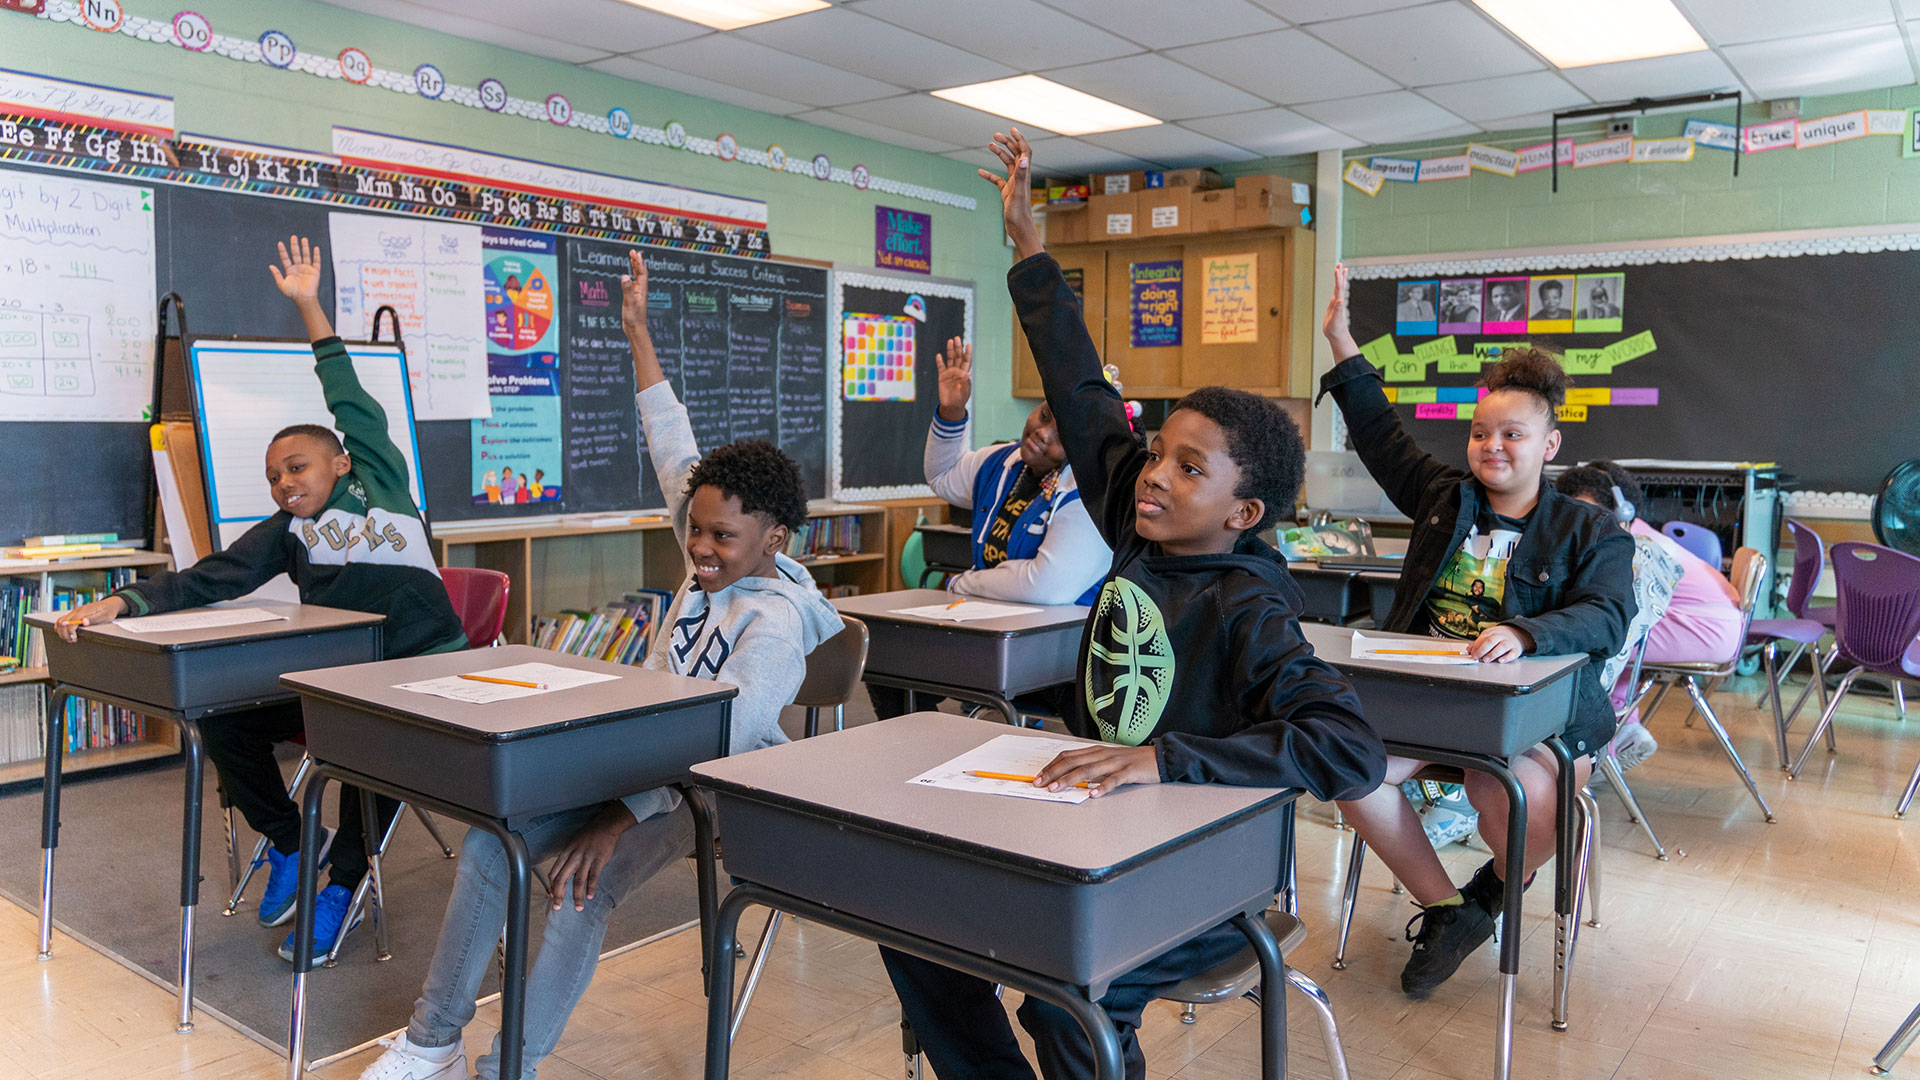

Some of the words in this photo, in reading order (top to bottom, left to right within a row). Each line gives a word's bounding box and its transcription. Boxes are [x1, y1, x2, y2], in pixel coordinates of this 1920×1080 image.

[87, 0, 116, 22] Nn
[178, 20, 208, 43] Oo
[267, 37, 291, 61] Pp
[344, 55, 366, 76] Qq
[420, 74, 441, 92] Rr
[483, 86, 502, 104] Ss
[551, 100, 566, 118] Tt
[613, 115, 629, 133] Uu
[1803, 119, 1856, 141] unique
[1, 122, 34, 146] Ee
[44, 126, 75, 153] Ff
[86, 135, 121, 163] Gg
[131, 140, 168, 166] Hh
[1751, 129, 1792, 146] true
[1470, 150, 1517, 170] punctual
[1519, 145, 1571, 165] HUMLE
[1575, 142, 1631, 164] yourself
[199, 151, 221, 174] Ii
[229, 156, 251, 182] Jj
[256, 158, 290, 184] Kk
[296, 165, 320, 188] Ll
[1420, 163, 1465, 175] confident
[356, 174, 393, 197] Mm
[399, 178, 427, 202] Nn
[431, 186, 456, 207] Oo
[40, 185, 60, 212] by
[69, 188, 82, 210] 2
[93, 191, 132, 221] Digit
[481, 192, 504, 215] Pp
[508, 197, 531, 219] Qq
[536, 200, 558, 222] Rr
[562, 203, 580, 224] Ss
[5, 214, 101, 240] Multiplication
[589, 209, 609, 229] Tt
[611, 212, 632, 233] Uu
[636, 217, 657, 236] Vv
[660, 220, 684, 239] Ww
[888, 211, 923, 236] Make
[377, 231, 412, 247] Good
[499, 236, 509, 245] to
[509, 237, 527, 248] Feel
[527, 239, 548, 249] Calm
[695, 224, 717, 244] Xx
[722, 229, 741, 250] Yy
[747, 232, 763, 250] Zz
[886, 232, 923, 255] effort.
[577, 243, 633, 278] Learning
[644, 254, 685, 272] ntentions
[690, 262, 705, 275] and
[711, 260, 749, 279] Success
[752, 265, 786, 286] Criteria
[878, 250, 892, 265] Not
[19, 257, 37, 276] 18
[70, 260, 97, 279] 414
[1136, 265, 1182, 281] Integrity
[579, 281, 609, 300] Math
[686, 291, 717, 307] Writing
[1140, 288, 1177, 302] doing
[730, 293, 749, 305] Social
[750, 294, 774, 307] Studies
[1150, 299, 1179, 314] right
[1141, 312, 1174, 327] thing
[1576, 351, 1602, 369] my
[115, 364, 142, 378] 414
[488, 375, 507, 386] olve
[508, 375, 550, 386] Problems
[1558, 406, 1585, 418] stice
[481, 419, 500, 428] Think
[481, 435, 509, 445] Explore
[481, 451, 497, 460] Pick
[302, 516, 408, 553] BUCKS
